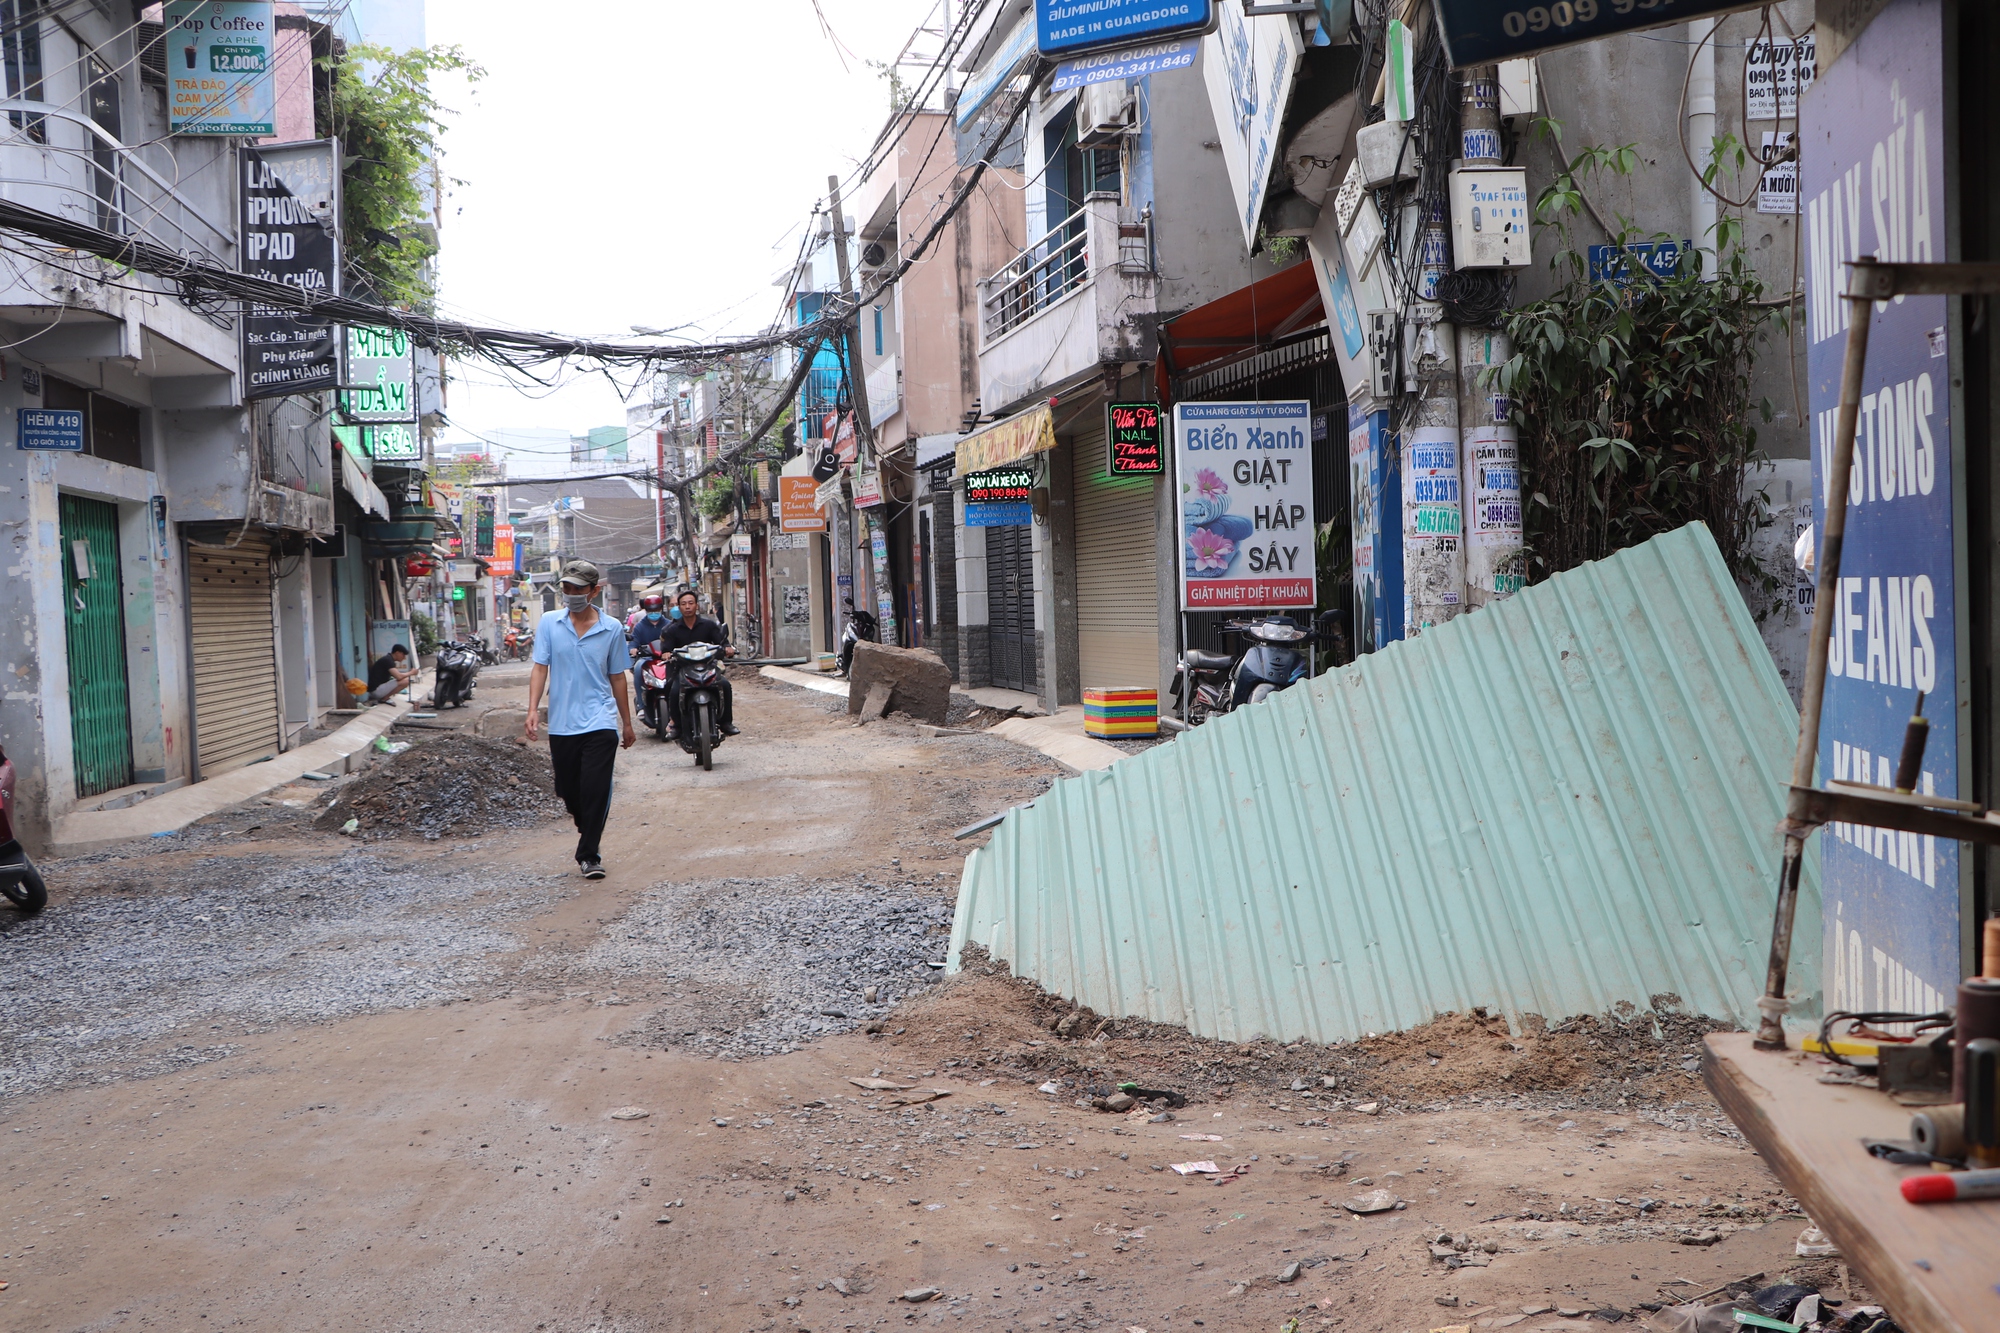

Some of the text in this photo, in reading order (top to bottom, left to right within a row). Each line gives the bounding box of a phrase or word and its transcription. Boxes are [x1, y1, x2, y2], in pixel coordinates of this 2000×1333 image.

[171, 15, 265, 33] Top Coffee
[1050, 4, 1189, 41] MADE IN GUANGDONG
[1503, 0, 1598, 37] 0909
[217, 35, 258, 44] CÀ PHÊ
[1072, 43, 1181, 71] MƯỜI QUANG
[1055, 53, 1191, 89] ĐT: 0903.341.846
[175, 78, 227, 90] TRÀ ĐÀO
[1749, 88, 1765, 98] BAO
[1790, 85, 1803, 96] GI
[175, 93, 201, 103] CAM
[1769, 174, 1795, 193] MƯỜI
[1809, 79, 1933, 345] MAY SỬA
[248, 232, 295, 260] iPAD
[294, 330, 307, 341] Tai
[263, 349, 315, 364] Phụ Kiện
[251, 363, 331, 385] CHÍNH HÃNG
[26, 412, 79, 427] HẺM 419
[1136, 408, 1157, 429] Tóc
[1186, 407, 1204, 416] CỬA
[1206, 407, 1230, 416] HÀNG
[1266, 406, 1278, 416] TỰ
[1278, 406, 1303, 416] ĐỘNG
[1312, 417, 1326, 430] 456
[1121, 429, 1153, 441] NAIL
[1187, 423, 1304, 451] Biển Xanh
[1819, 372, 1935, 509] VSTONS
[1114, 442, 1158, 456] Thanh
[1476, 445, 1495, 459] CẤM
[1115, 457, 1158, 470] Thanh
[969, 472, 1030, 490] DẠY LÁI XE Ô TÔ
[1233, 456, 1292, 490] GIẶT
[791, 480, 813, 490] Piano
[972, 487, 1027, 498] 090 190 86 86
[790, 492, 815, 500] Guitar
[783, 502, 805, 510] Thanh
[1254, 499, 1306, 531] HẤP
[496, 529, 512, 538] KERY
[499, 541, 512, 558] Bin
[1248, 541, 1299, 573] SẤY
[1191, 582, 1308, 602] GIẶT NHIỆT DIỆT KHUẨN
[1828, 574, 1936, 695] JEANS
